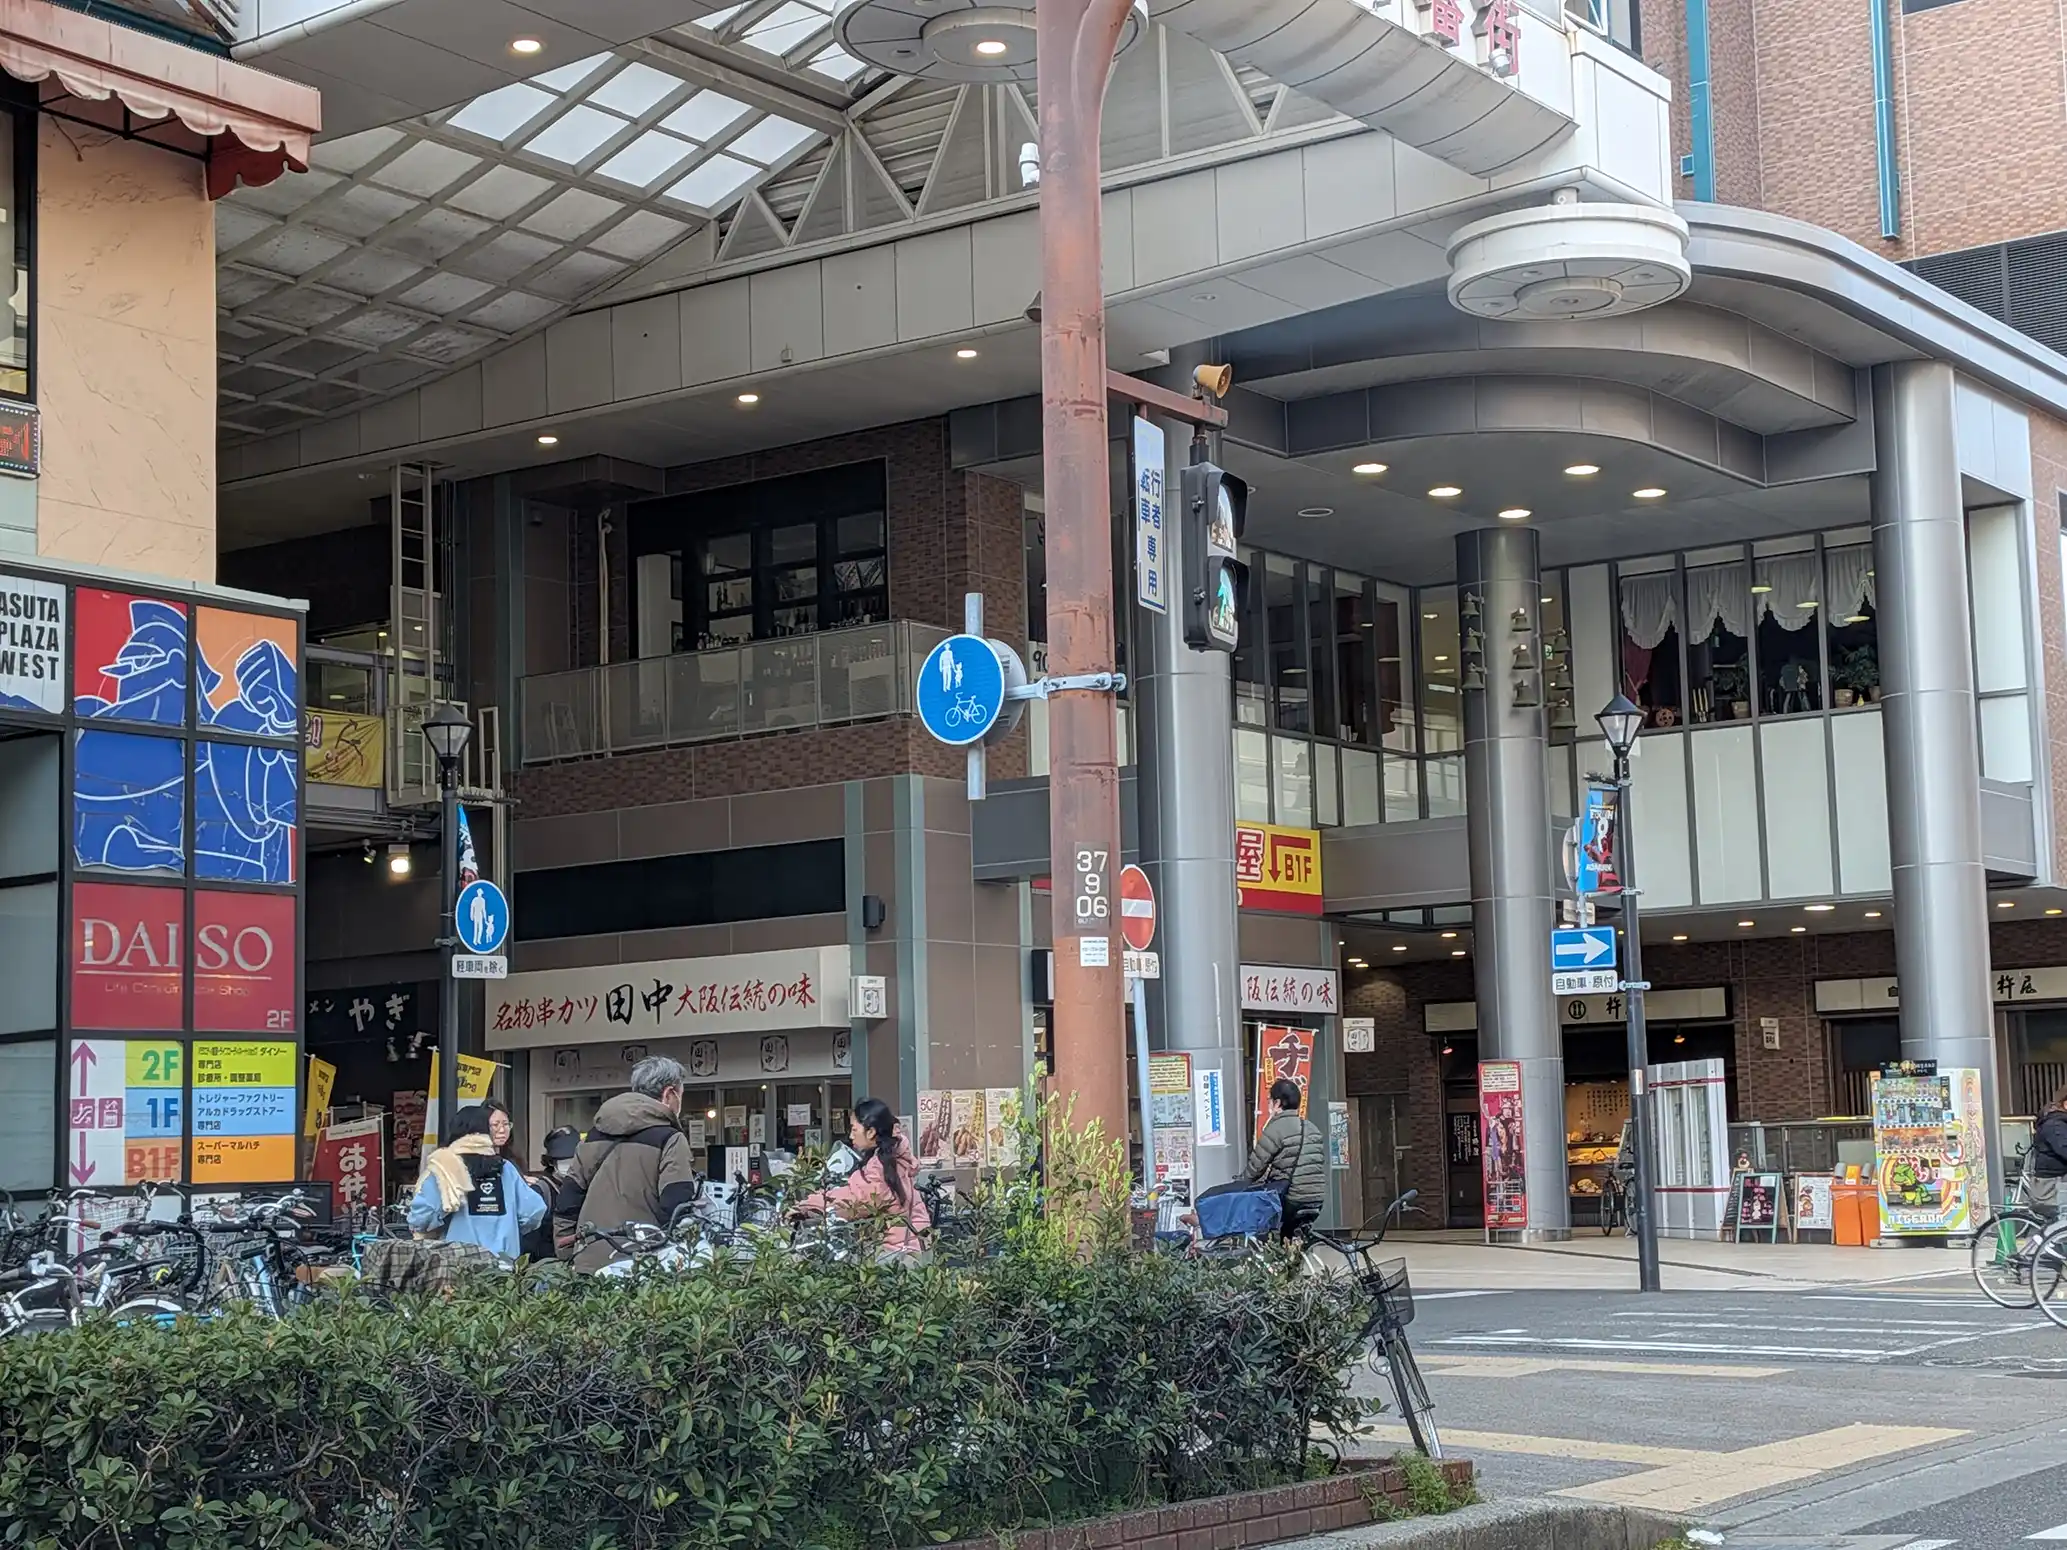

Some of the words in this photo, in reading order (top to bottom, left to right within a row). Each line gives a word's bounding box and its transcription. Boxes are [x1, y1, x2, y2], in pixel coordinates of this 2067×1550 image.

[1076, 850, 1108, 872] 37
[1284, 853, 1312, 883] B1F
[1085, 873, 1101, 895] 9
[1076, 895, 1109, 918] 06
[80, 918, 273, 972] DAISO
[1555, 976, 1614, 990] 自動車・原付
[266, 1010, 292, 1028] 2F
[142, 1050, 179, 1080] 2F
[147, 1098, 179, 1128] 1F
[197, 1141, 260, 1150] スーパーマルハチ
[127, 1147, 180, 1178] B1F
